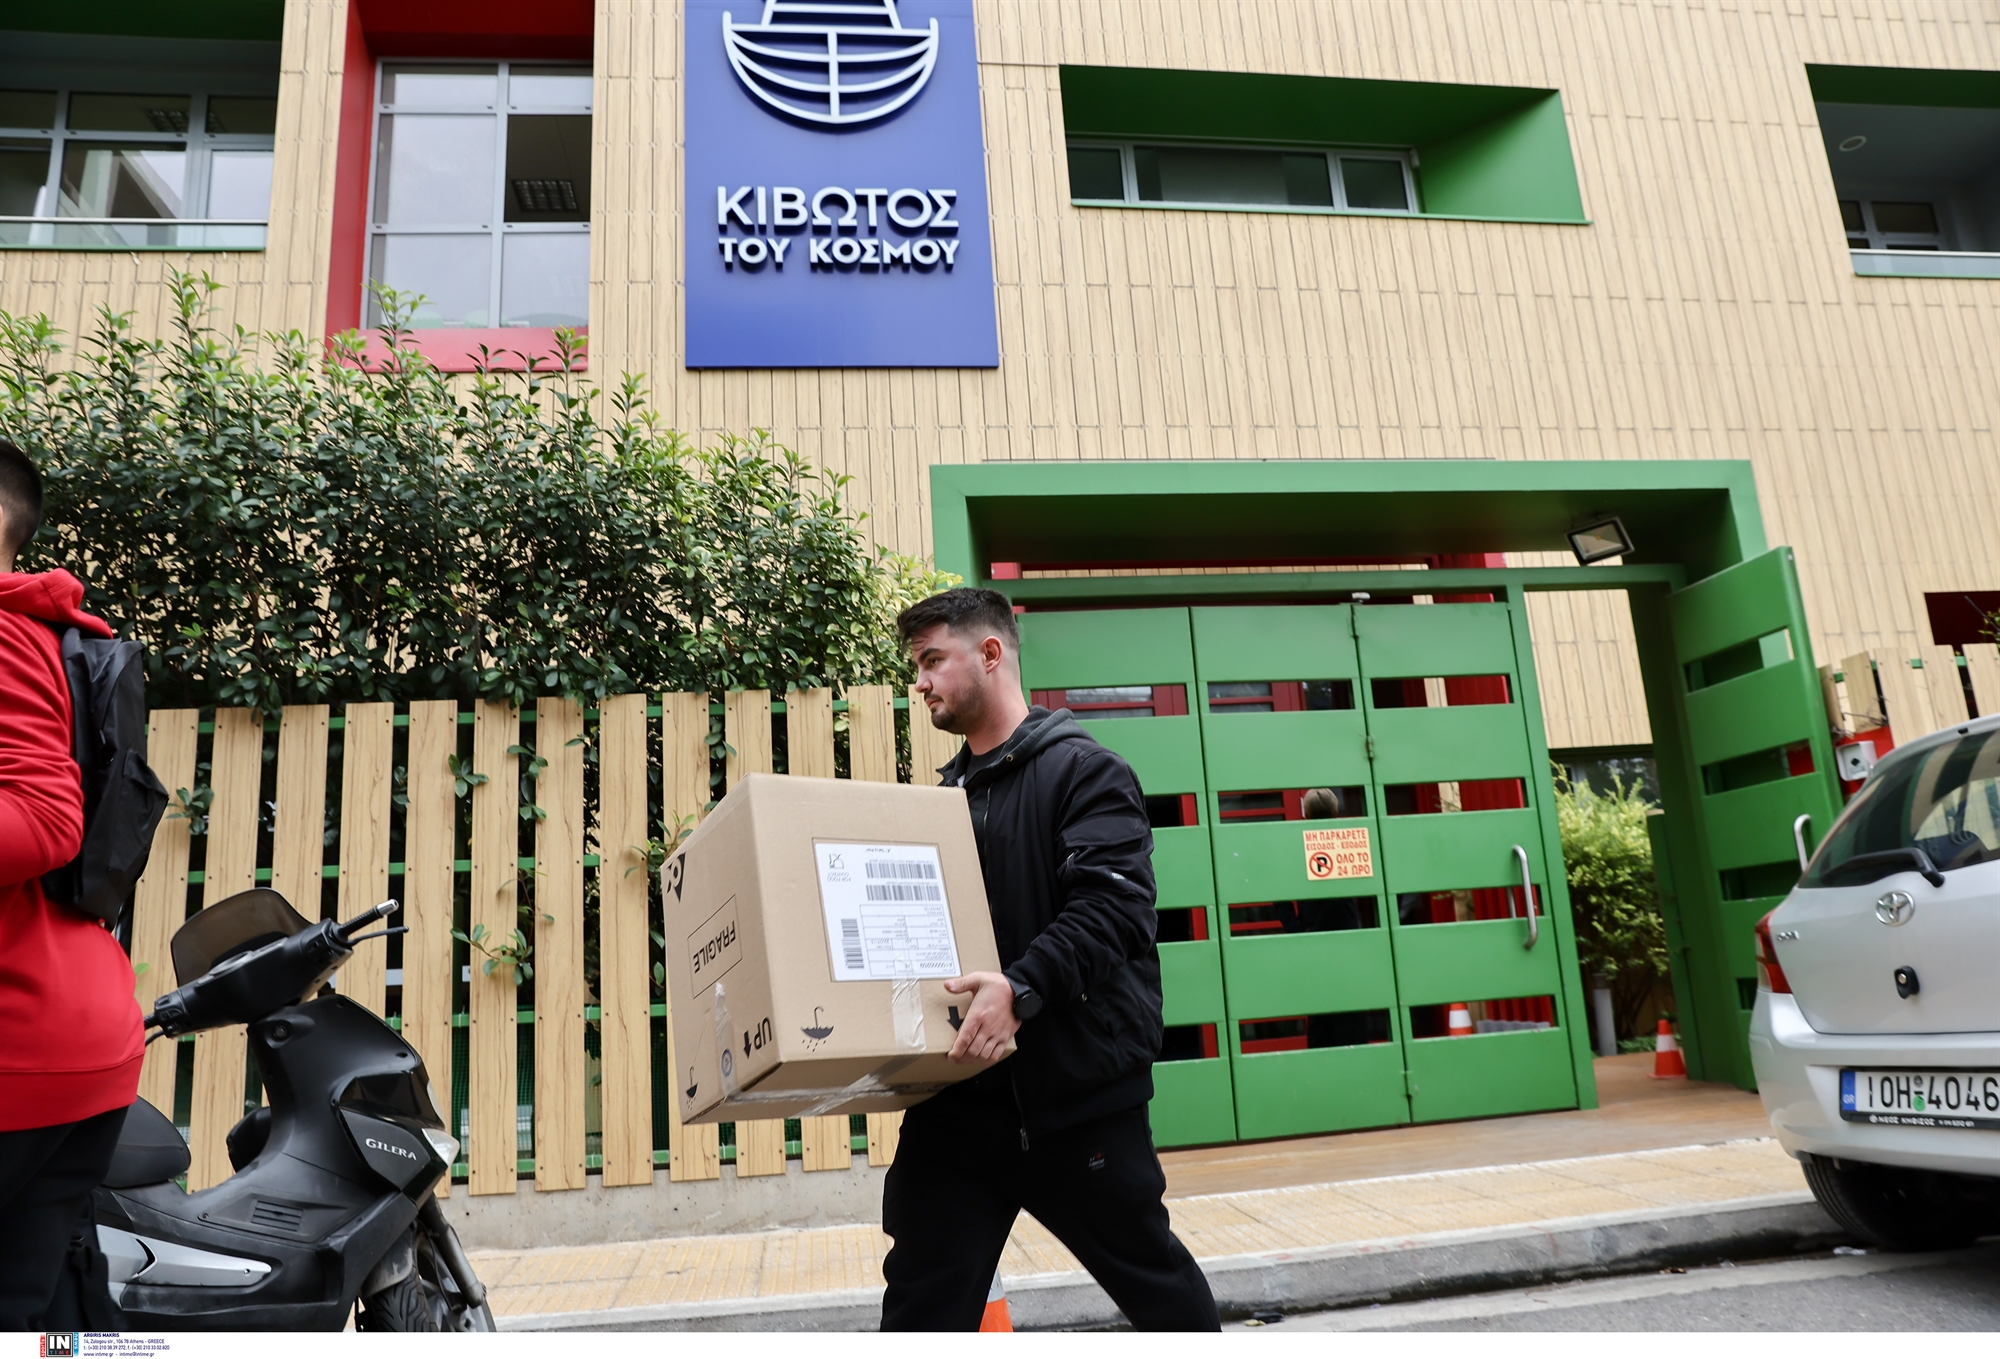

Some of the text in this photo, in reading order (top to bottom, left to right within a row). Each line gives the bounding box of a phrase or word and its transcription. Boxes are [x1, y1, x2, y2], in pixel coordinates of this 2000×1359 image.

[717, 186, 960, 231] ΚΙΒΩΤΟΣ
[718, 237, 961, 269] ΤΟΥ ΚΟΣΜΟΥ
[1305, 829, 1366, 841] ΜΗ ΠΑΡΚΑΡΕΤΕ
[1306, 842, 1335, 851] ΕΙΣΟΔΟΣ
[1341, 840, 1367, 849] ΕΞΟΔΟΣ
[1336, 852, 1369, 863] ΟΛΟ ΤΟ
[1338, 864, 1371, 876] 24 ΩΡΟ
[692, 920, 737, 974] FRAGILE
[754, 1017, 773, 1050] UP
[365, 1138, 417, 1161] GILERA
